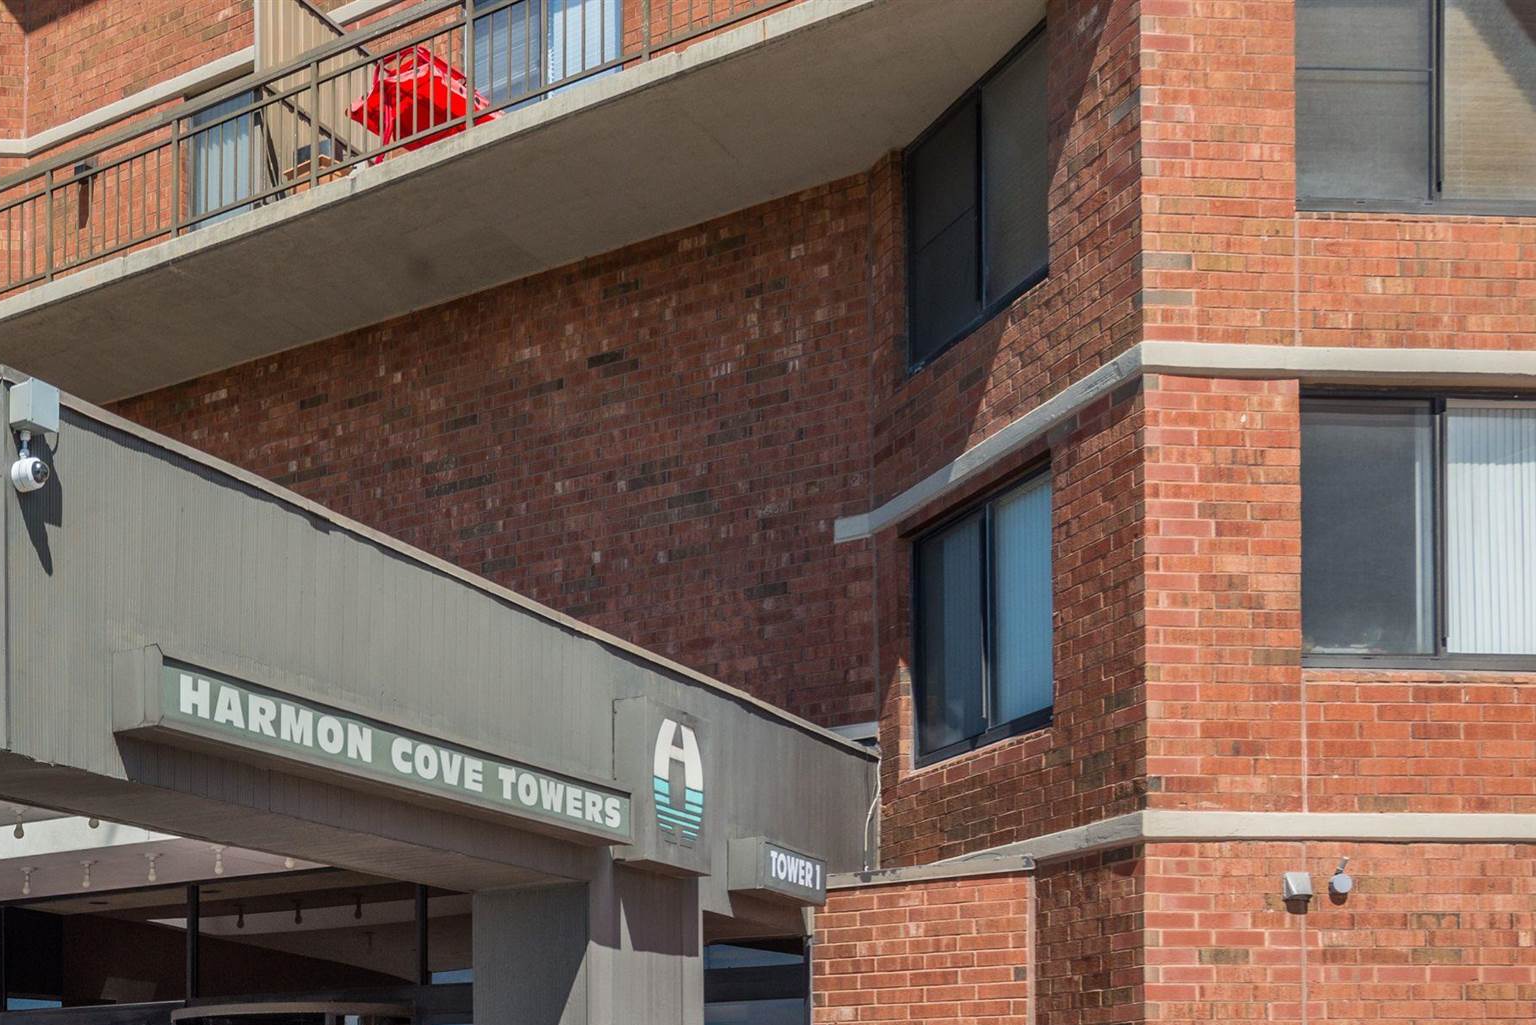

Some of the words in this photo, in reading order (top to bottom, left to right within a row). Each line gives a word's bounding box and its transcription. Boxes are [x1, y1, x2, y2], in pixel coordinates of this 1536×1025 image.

[179, 673, 372, 763] HARMON
[391, 737, 484, 793] COVE
[498, 766, 621, 829] TOWERS
[770, 850, 813, 888] TOWER
